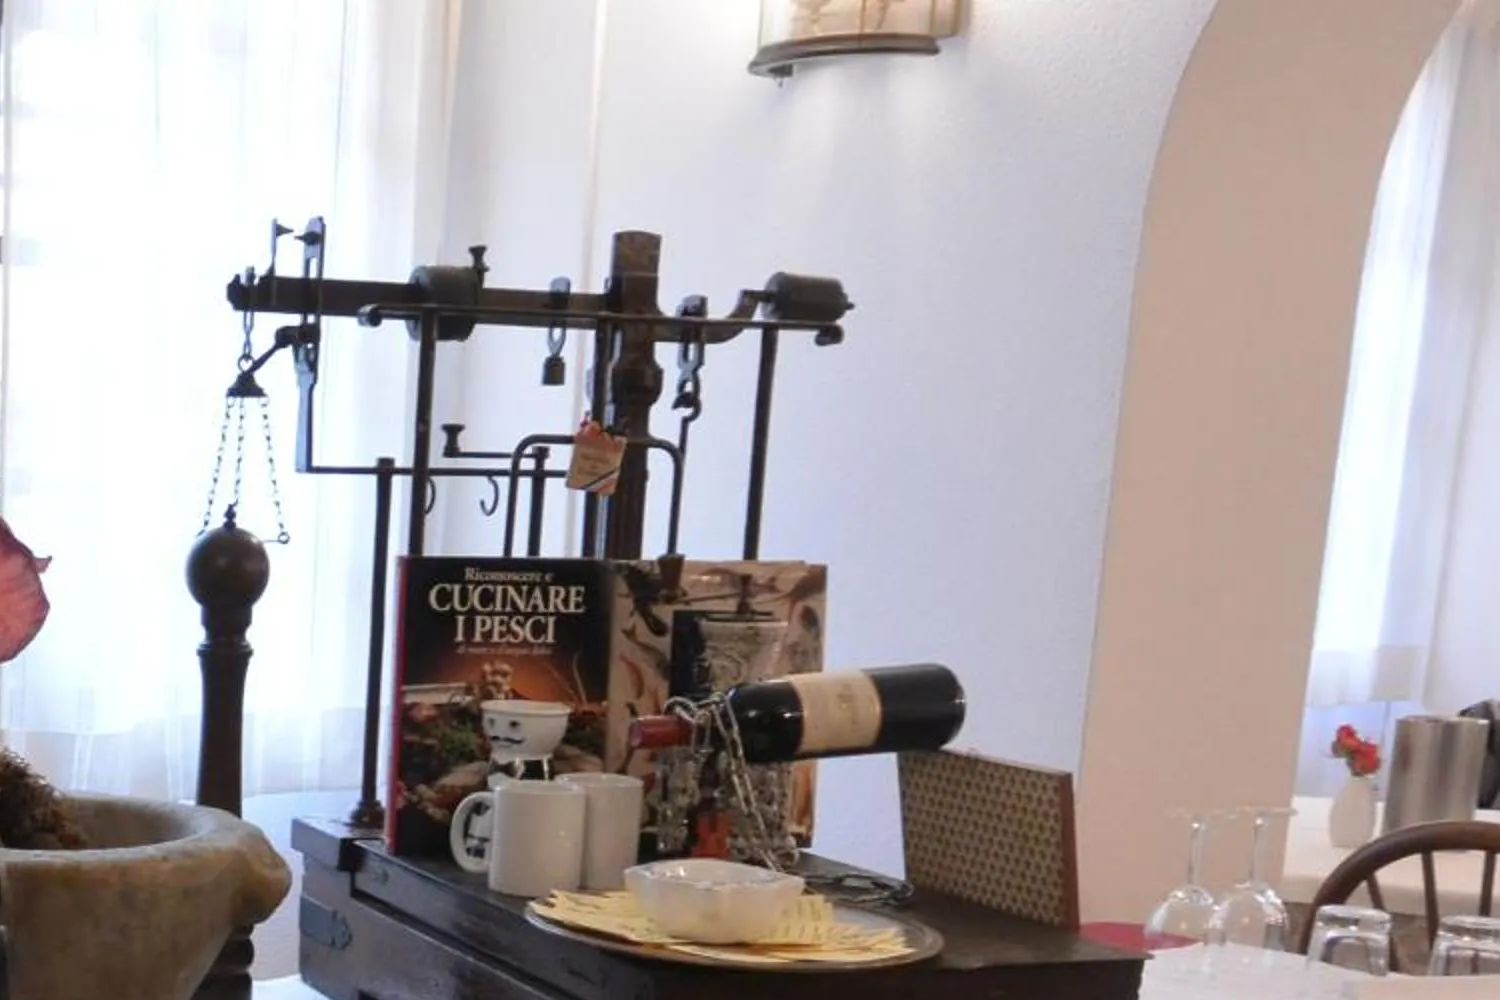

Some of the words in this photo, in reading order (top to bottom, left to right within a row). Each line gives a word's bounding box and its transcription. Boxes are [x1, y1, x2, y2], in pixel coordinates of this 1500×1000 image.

[428, 583, 586, 613] CUCINARE
[454, 615, 467, 643] I
[473, 615, 558, 643] PESCI
